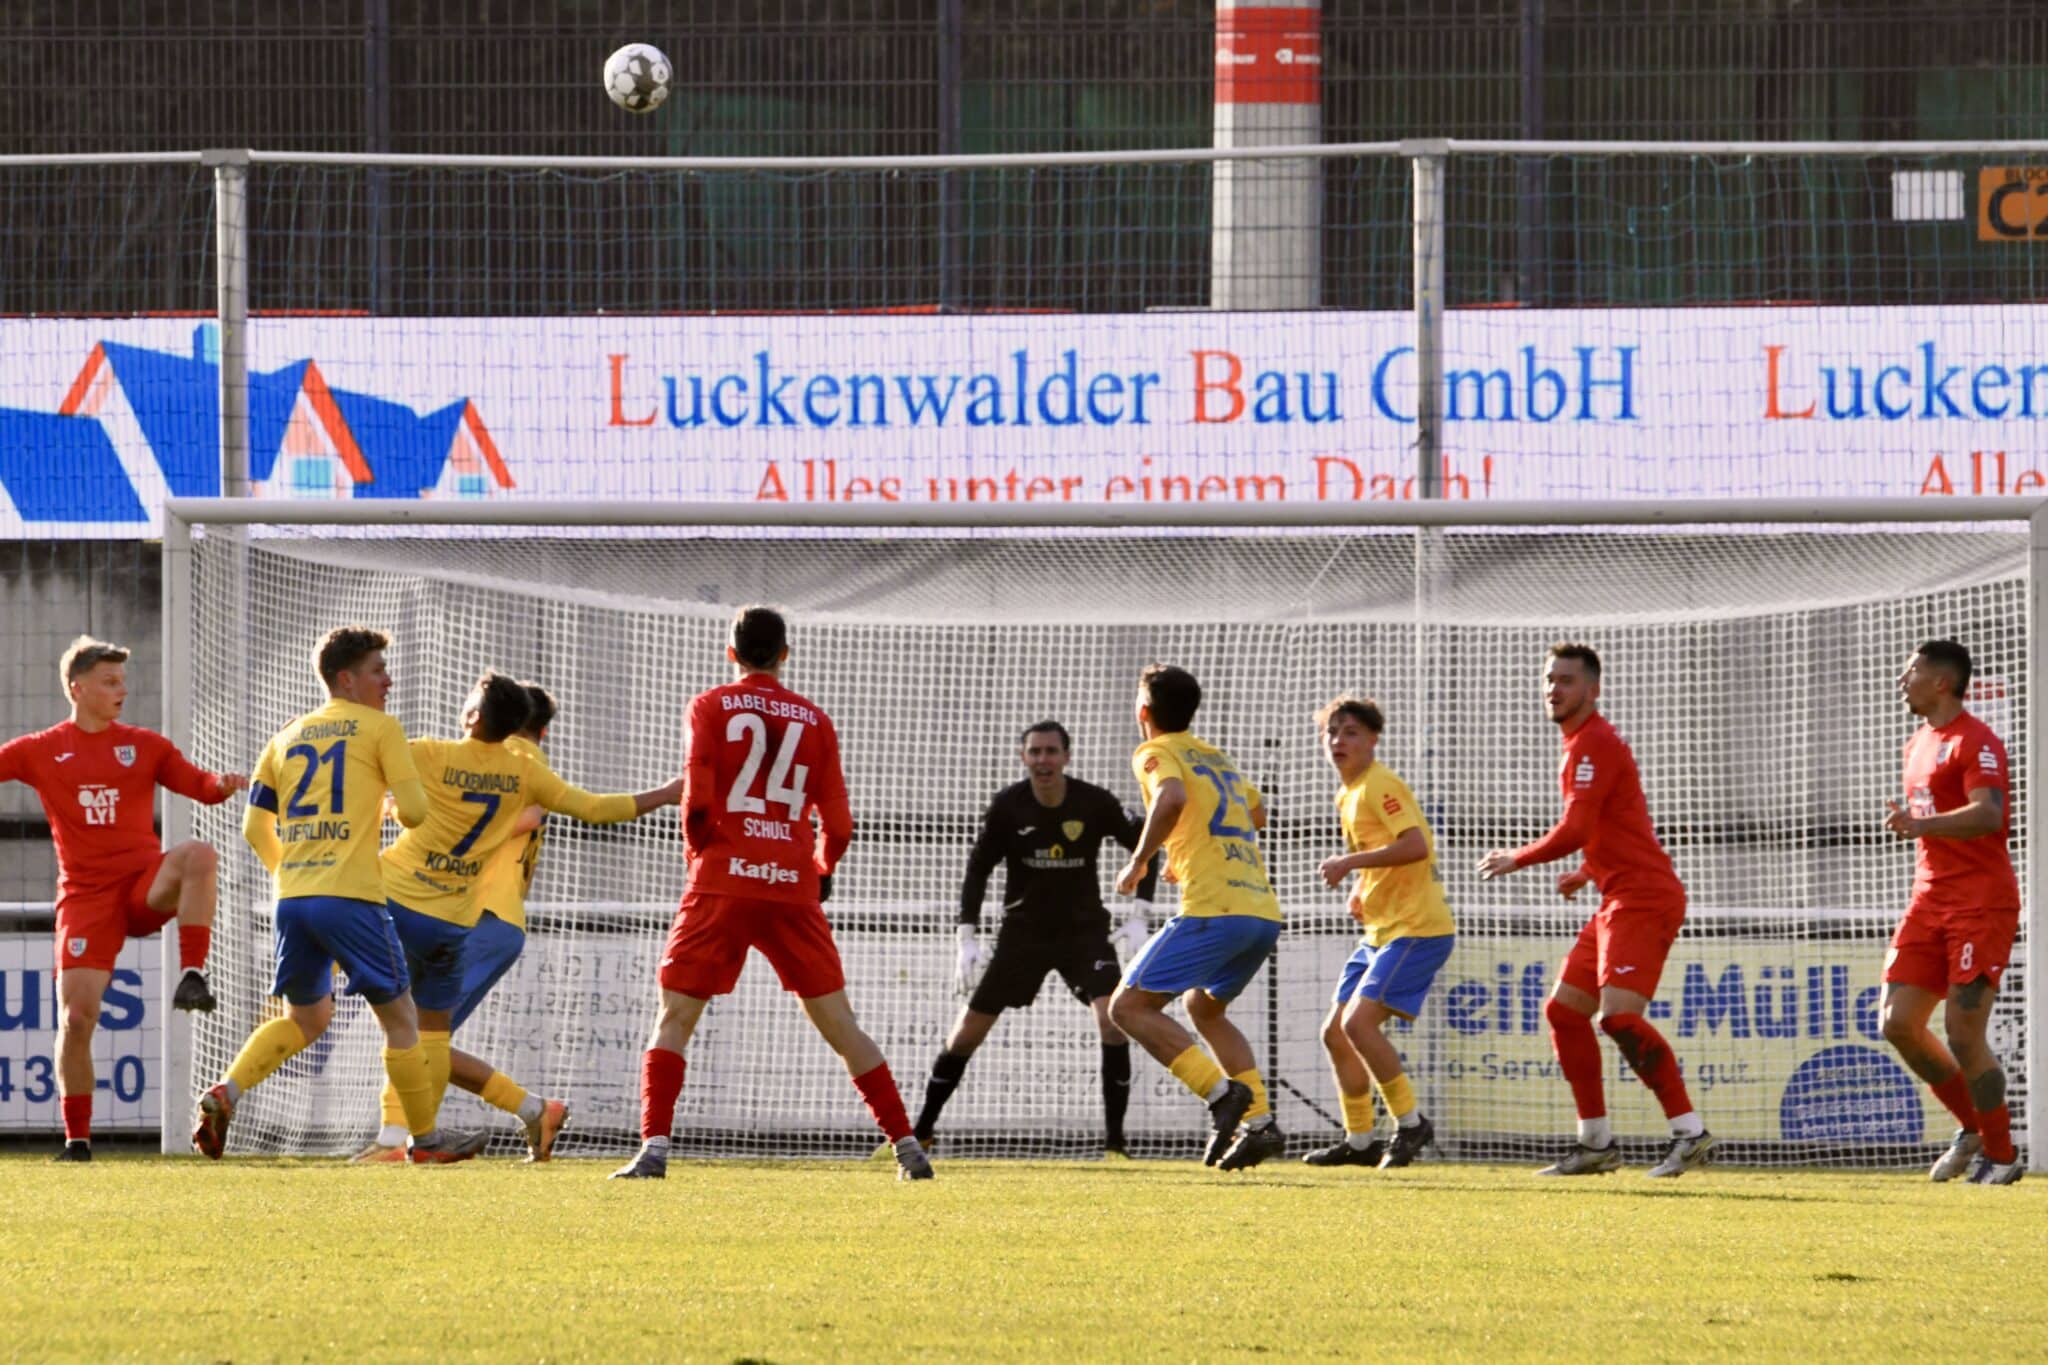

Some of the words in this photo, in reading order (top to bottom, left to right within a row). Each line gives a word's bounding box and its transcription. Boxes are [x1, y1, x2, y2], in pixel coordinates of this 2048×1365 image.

[607, 350, 1160, 428] Luckenwalder
[1190, 350, 1343, 424] Bau
[721, 694, 818, 726] BABELSBERG
[286, 740, 347, 819] 21
[725, 712, 809, 822] 24
[450, 791, 501, 857] 7
[744, 817, 793, 841] SCHULZ
[1192, 765, 1256, 842] 25
[728, 857, 799, 884] Katjes
[1960, 942, 1974, 971] 8
[0, 969, 145, 1030] us
[0, 1055, 145, 1102] 3-0
